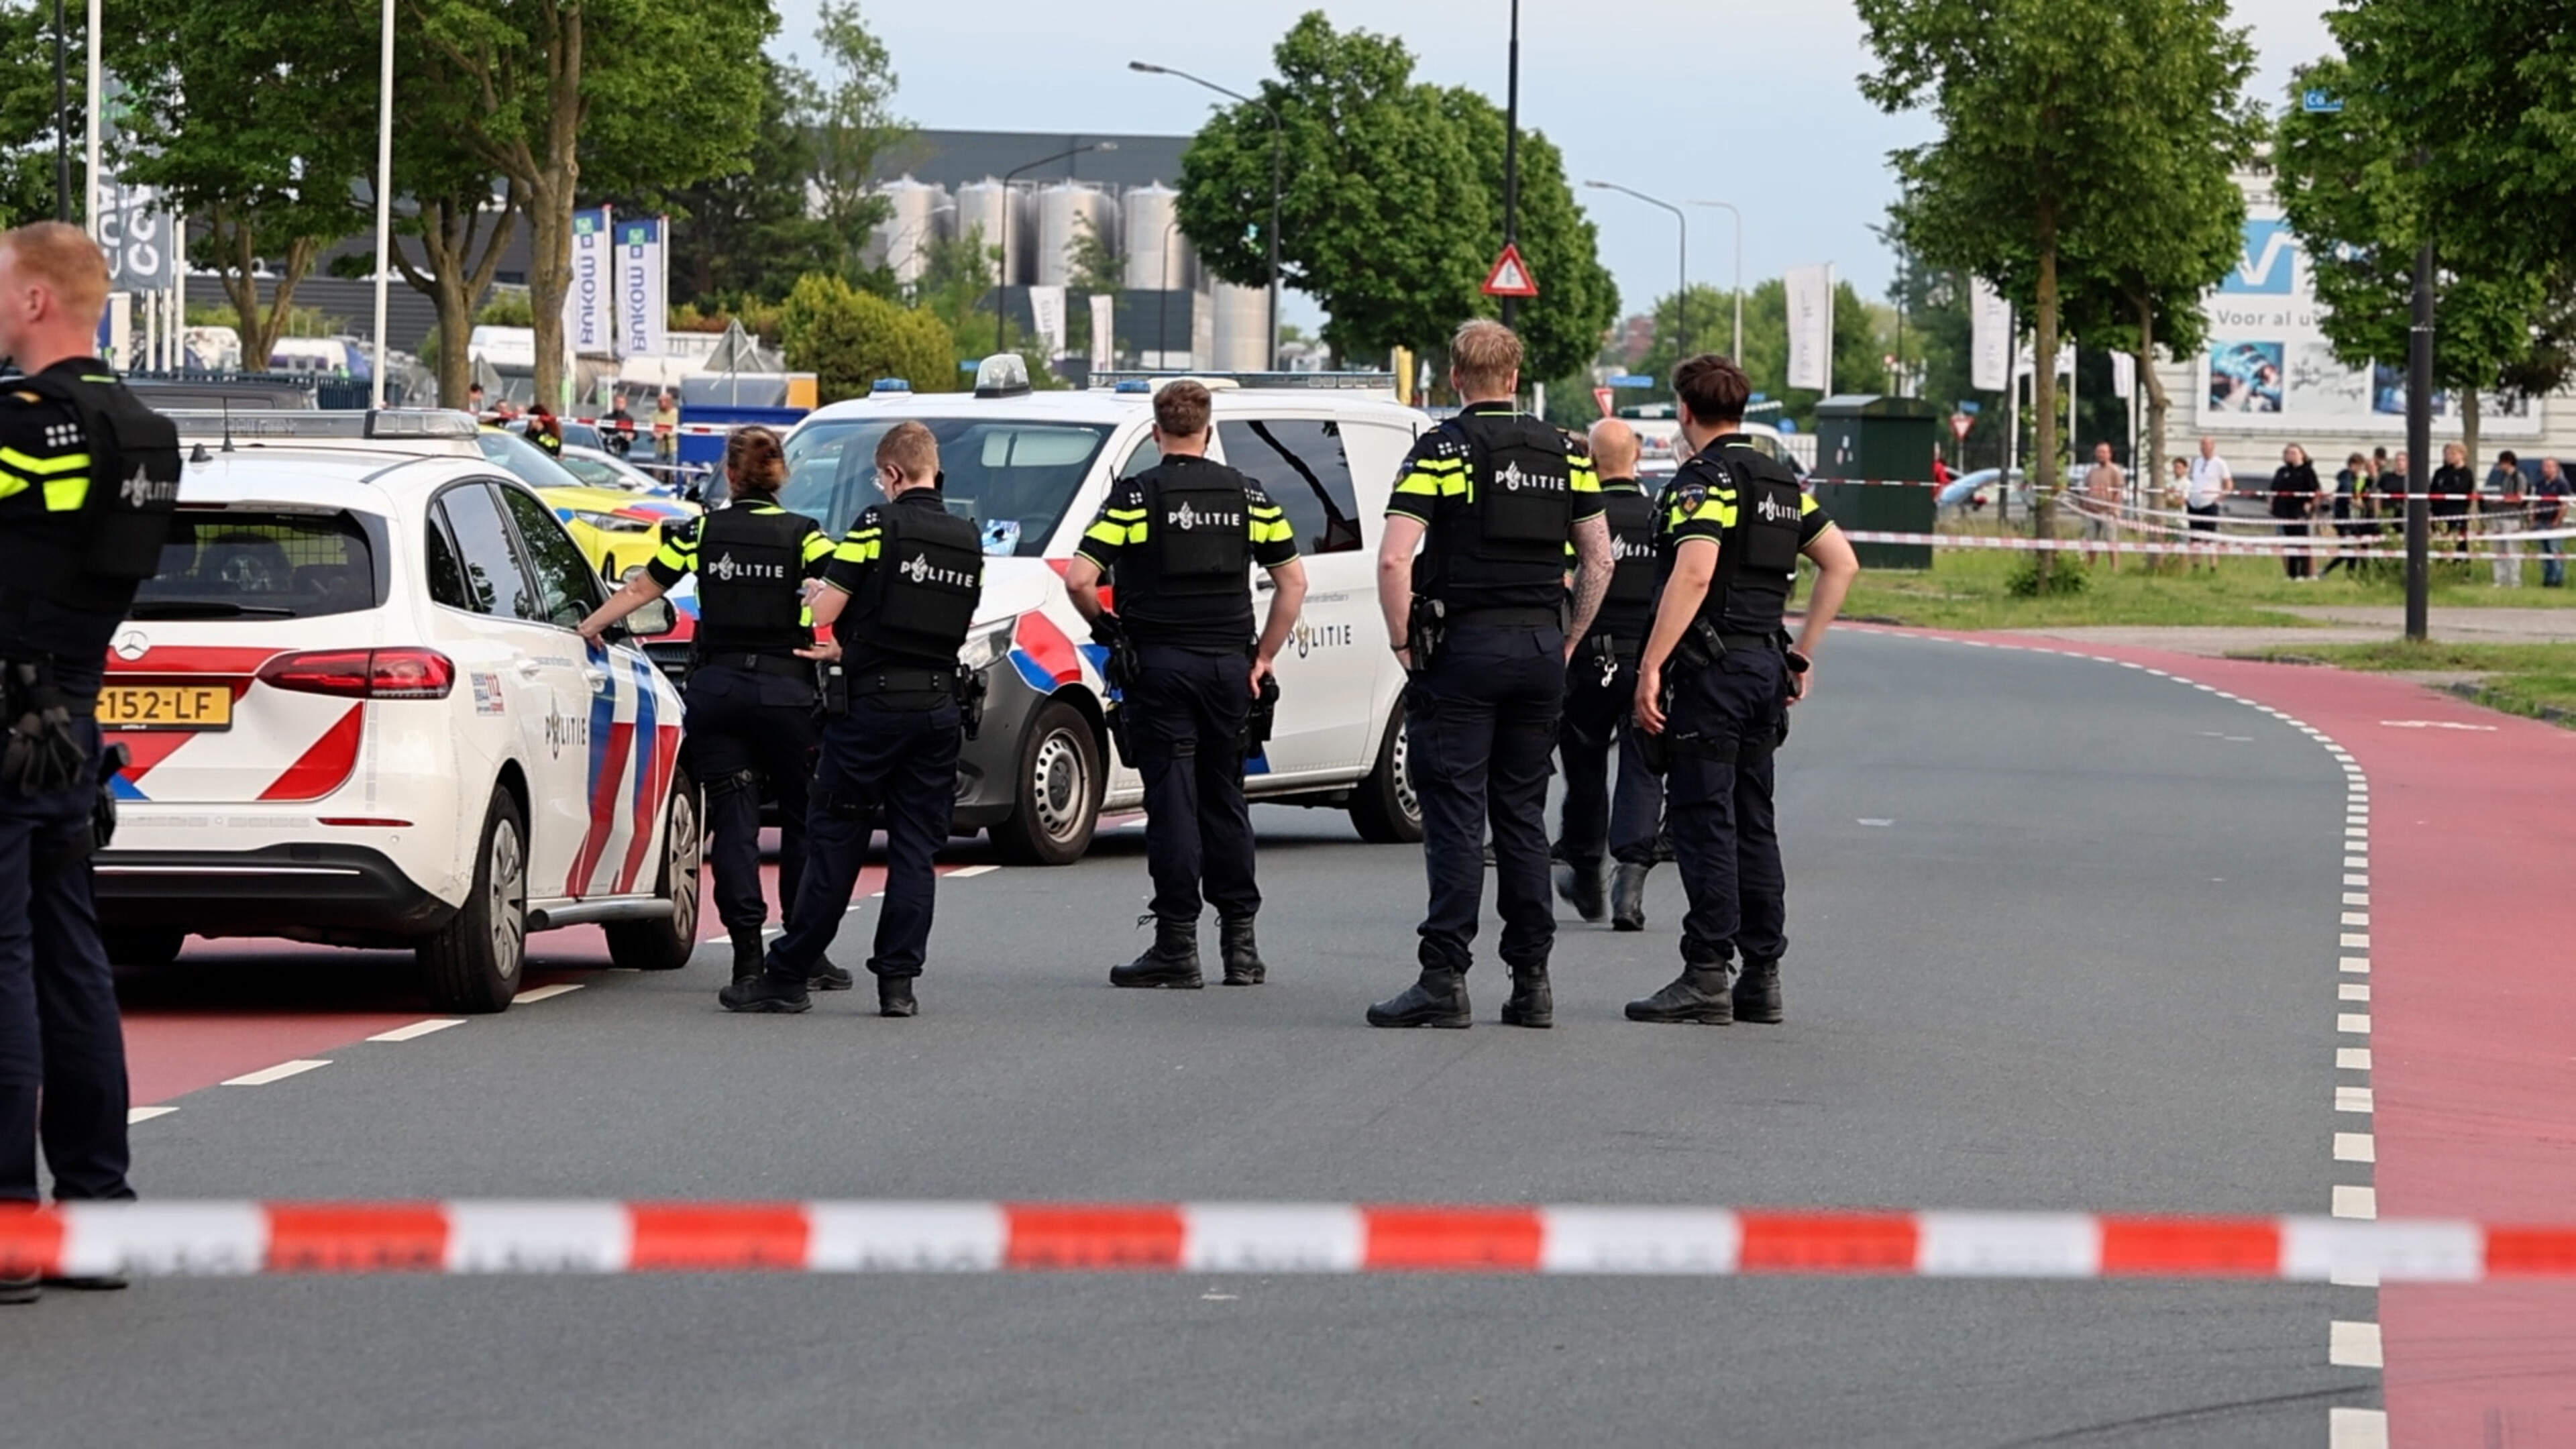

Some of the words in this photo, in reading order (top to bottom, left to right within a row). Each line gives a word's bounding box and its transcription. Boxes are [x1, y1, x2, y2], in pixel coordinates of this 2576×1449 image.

[2216, 309, 2265, 326] Voor
[2273, 311, 2291, 326] al
[1495, 464, 1565, 490] POLITIE
[1169, 505, 1240, 529] POLITIE
[1758, 496, 1802, 521] POLITIE
[709, 555, 784, 580] POLITIE
[900, 556, 974, 588] POLITIE
[1287, 617, 1351, 658] POLITIE
[97, 691, 212, 719] -152-LF
[545, 704, 586, 759] POLITIE
